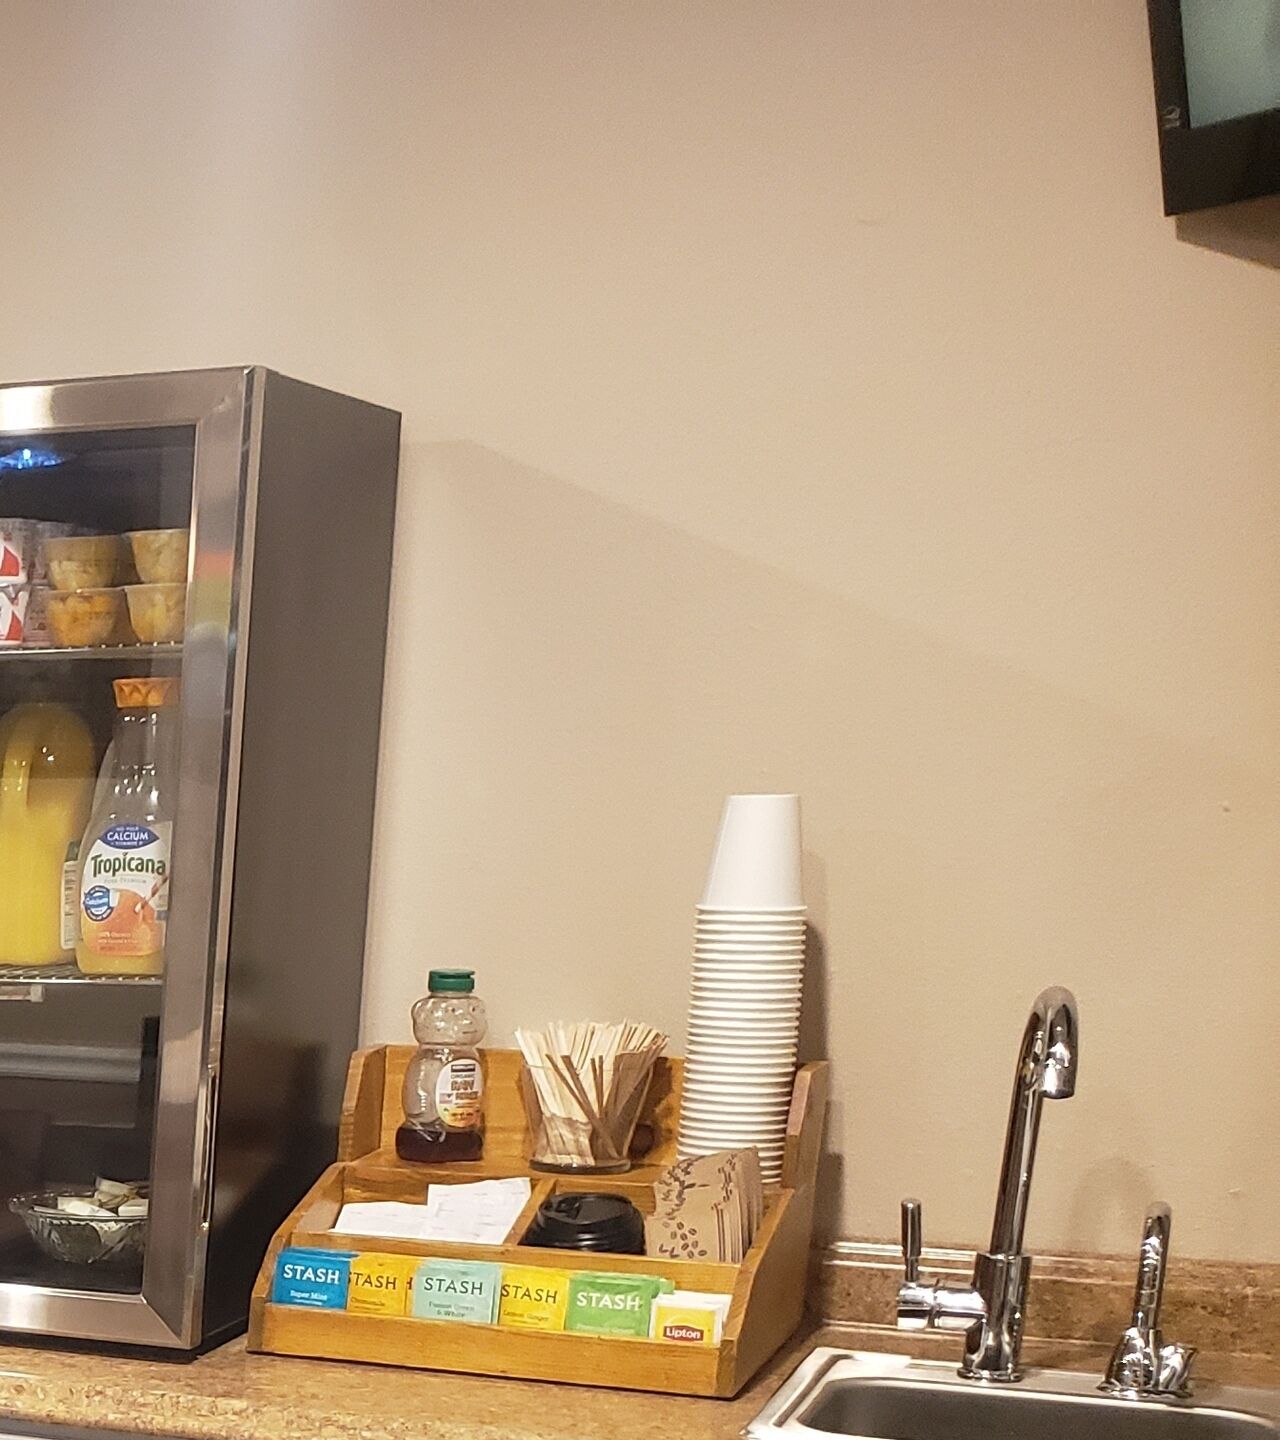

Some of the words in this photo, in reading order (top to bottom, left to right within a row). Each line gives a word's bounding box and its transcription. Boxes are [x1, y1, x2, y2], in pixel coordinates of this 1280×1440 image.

[107, 831, 149, 841] CALCIUM
[91, 852, 166, 877] Tropicana
[283, 1264, 340, 1285] STASH
[424, 1277, 483, 1296] STASH
[501, 1284, 558, 1304] STASH
[576, 1291, 640, 1311] STASH
[666, 1327, 701, 1340] Lipton
